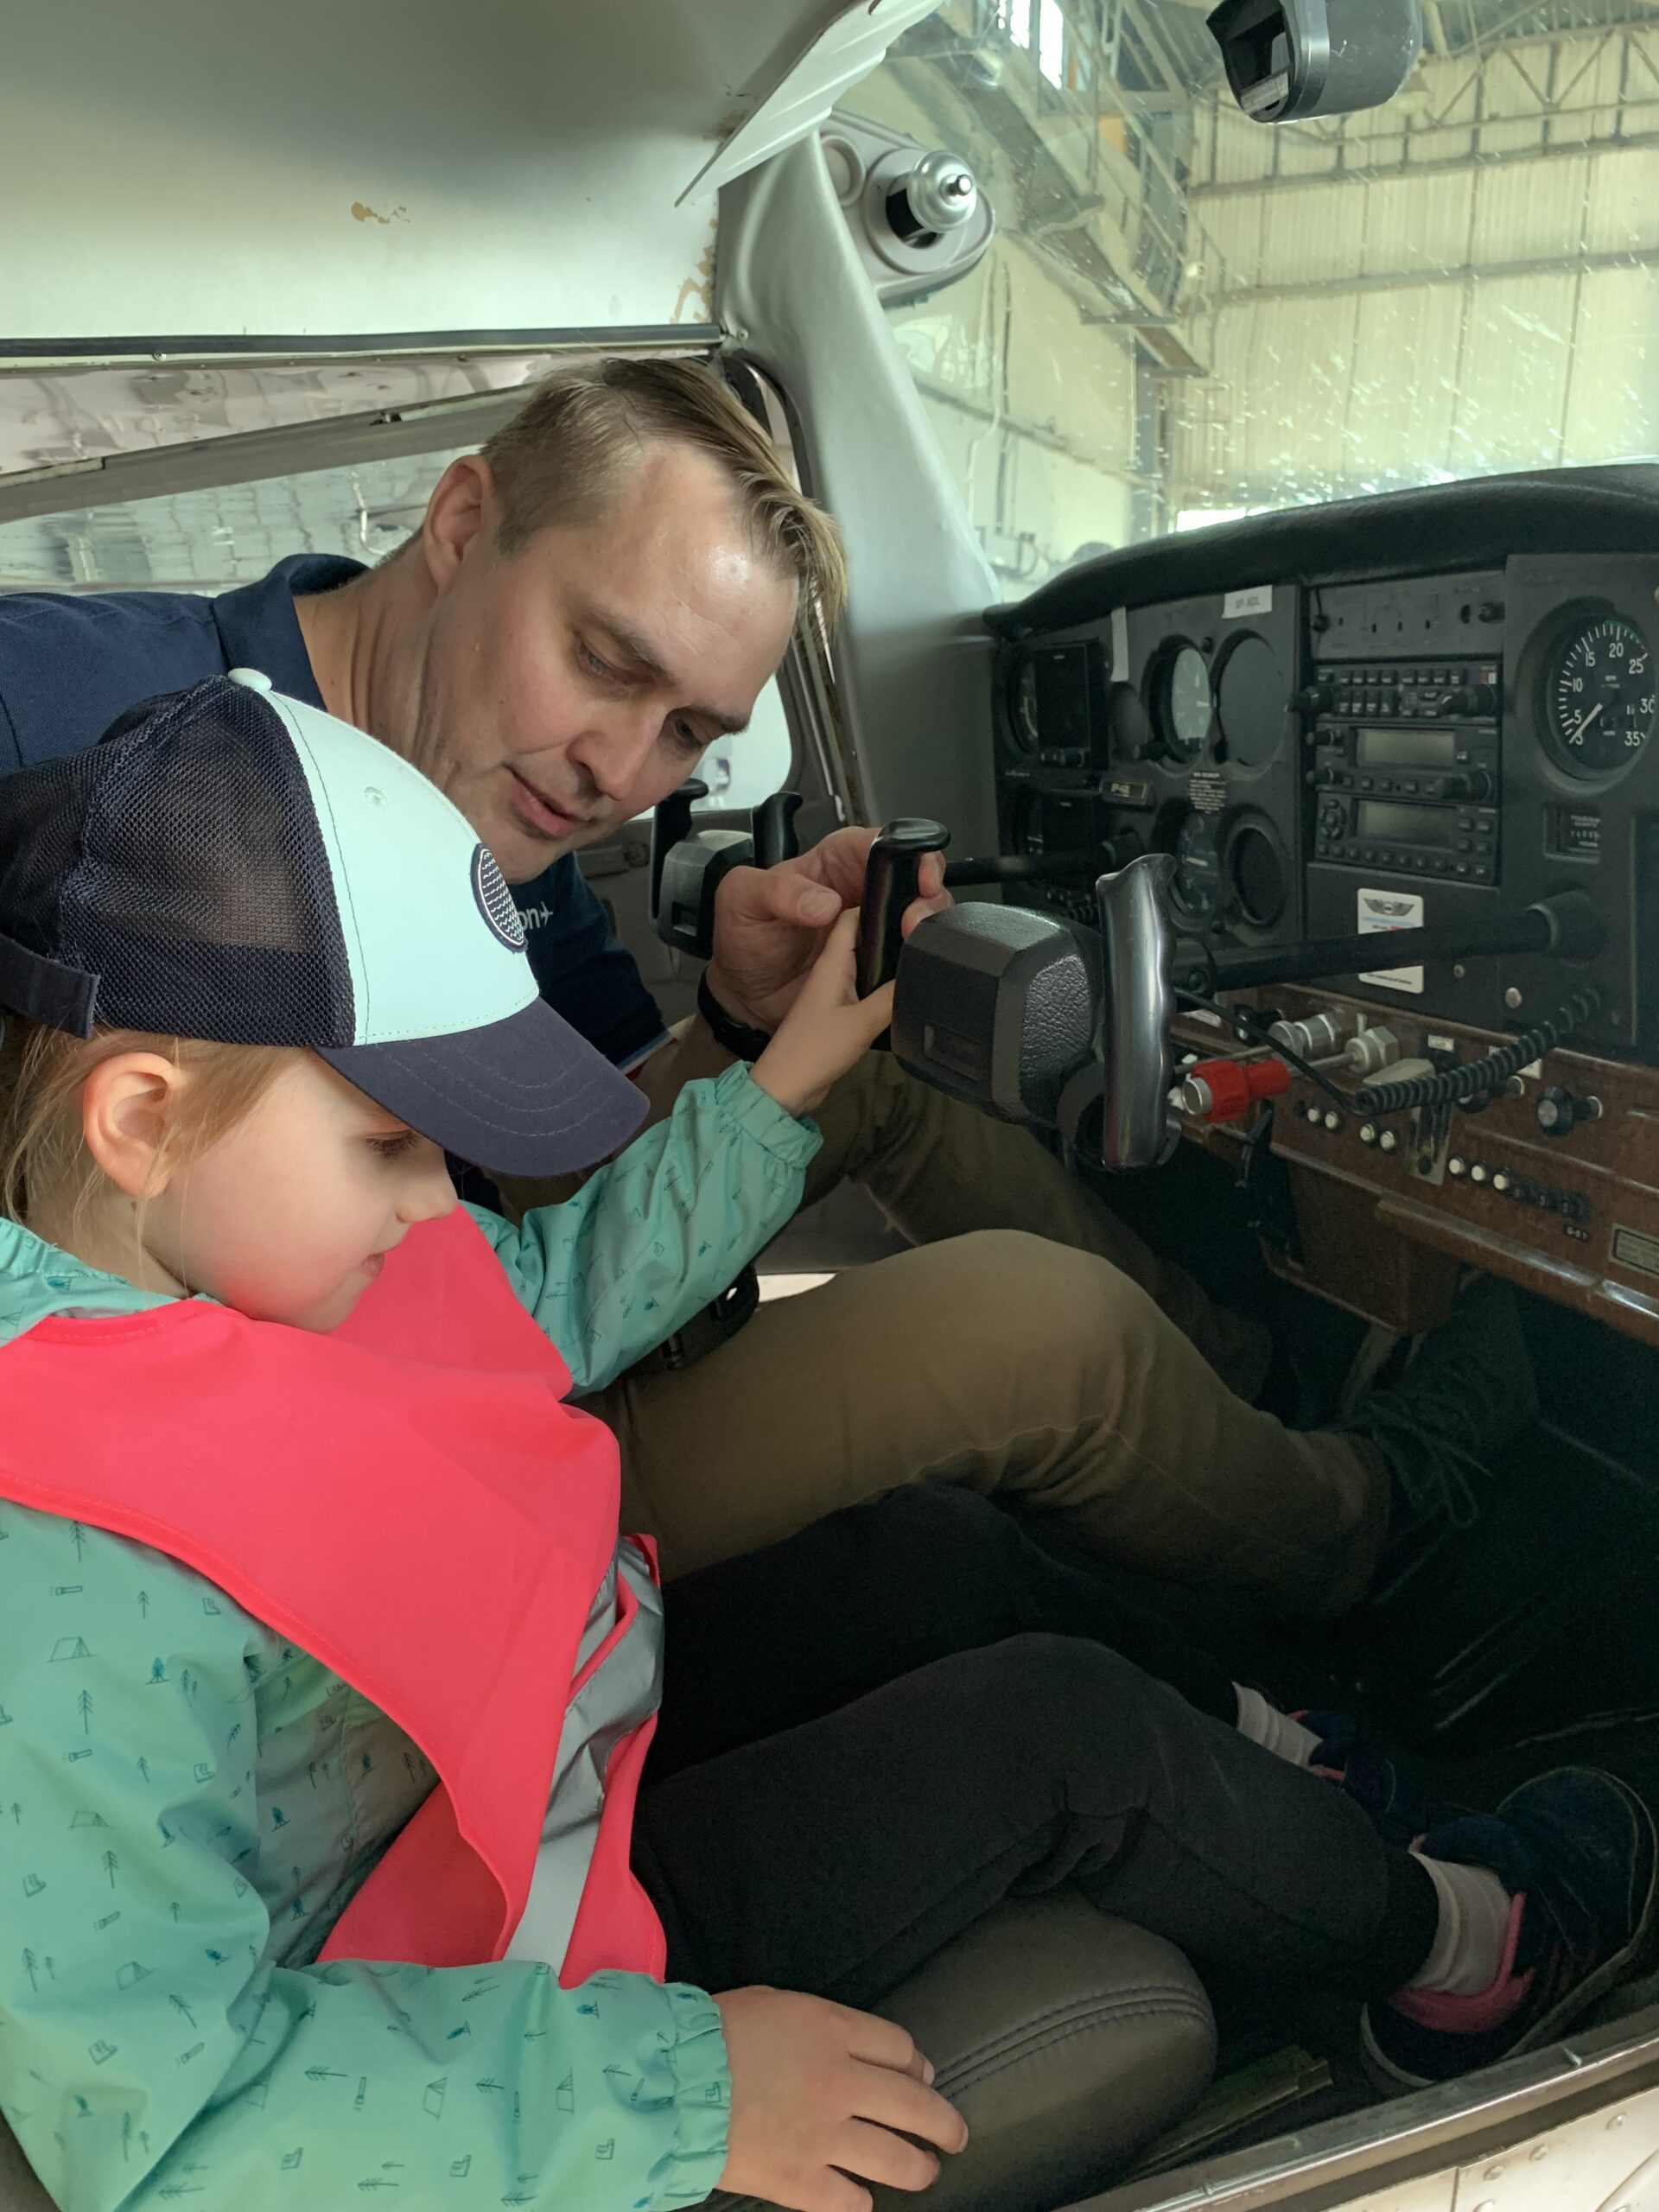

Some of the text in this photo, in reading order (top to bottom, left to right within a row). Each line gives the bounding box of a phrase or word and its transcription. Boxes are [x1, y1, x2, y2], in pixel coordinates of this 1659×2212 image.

[1609, 642, 1624, 658] 20
[1586, 652, 1596, 667] 15
[1629, 658, 1643, 674] 25
[1573, 677, 1583, 692] 10
[1640, 697, 1655, 714] 30
[1573, 709, 1582, 724] 5
[1624, 731, 1640, 746] 35
